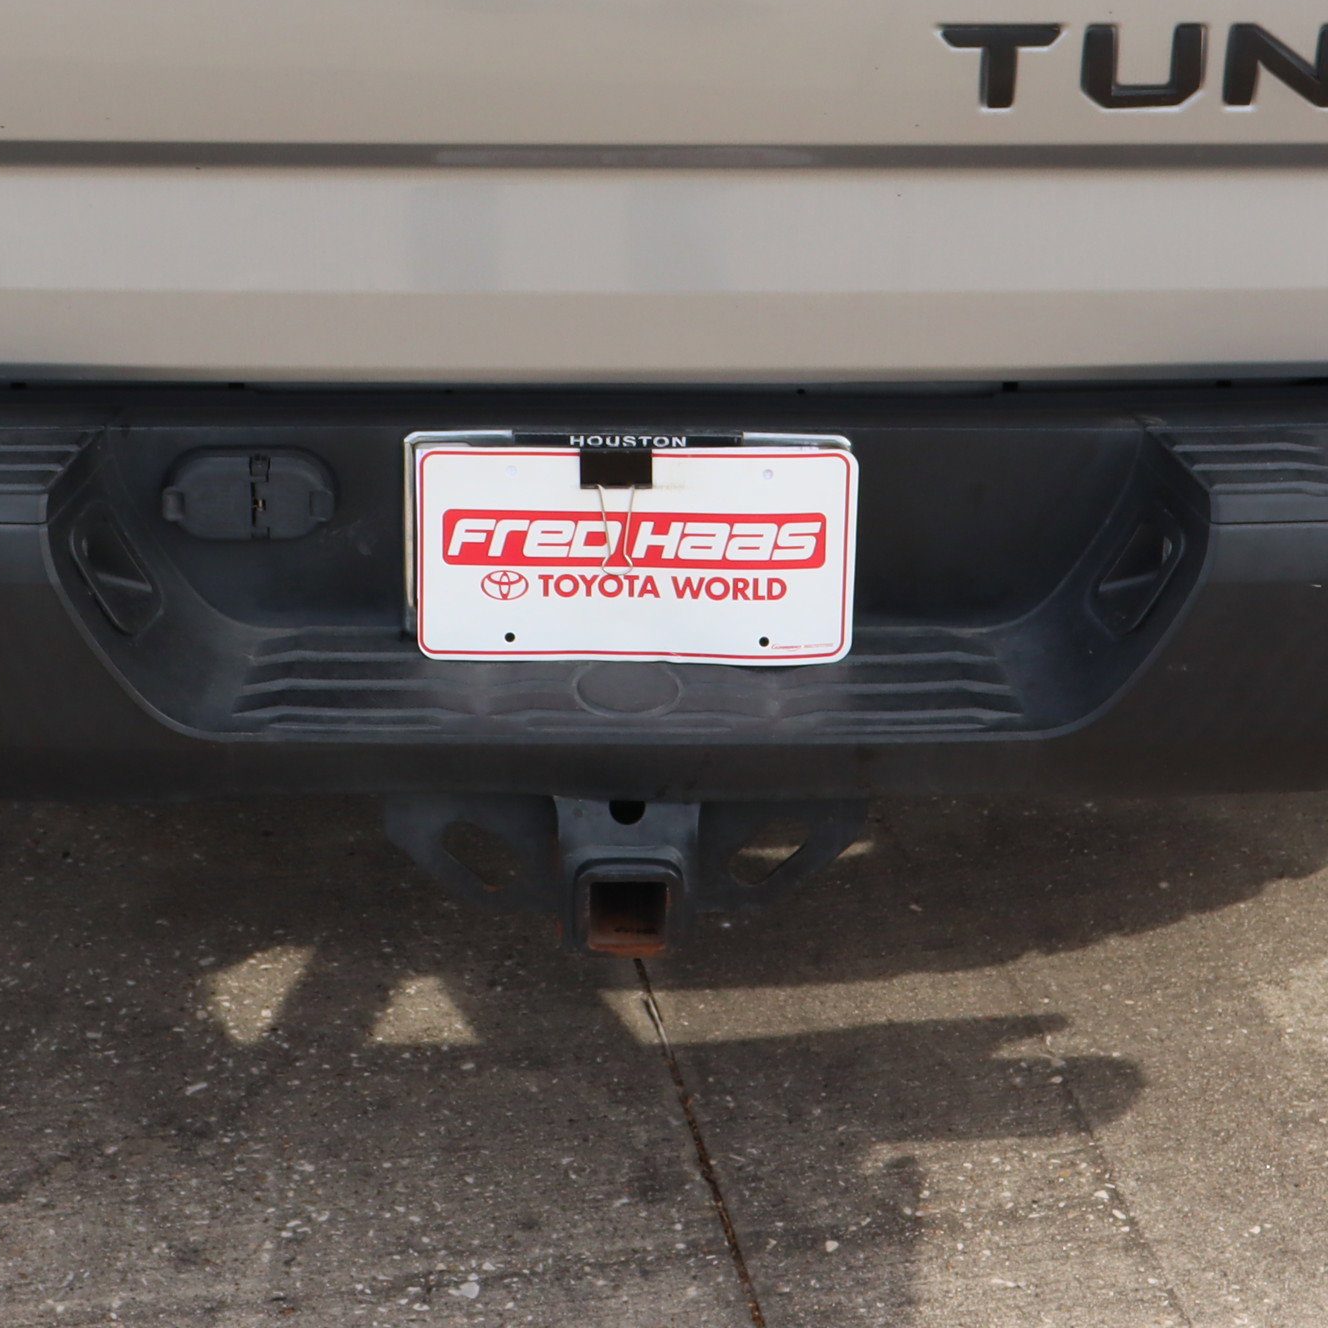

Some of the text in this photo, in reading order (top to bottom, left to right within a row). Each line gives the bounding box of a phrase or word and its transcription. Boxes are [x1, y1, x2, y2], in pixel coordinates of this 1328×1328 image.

[569, 435, 687, 448] HOUSTON
[538, 574, 788, 601] TOYOTA WORLD
